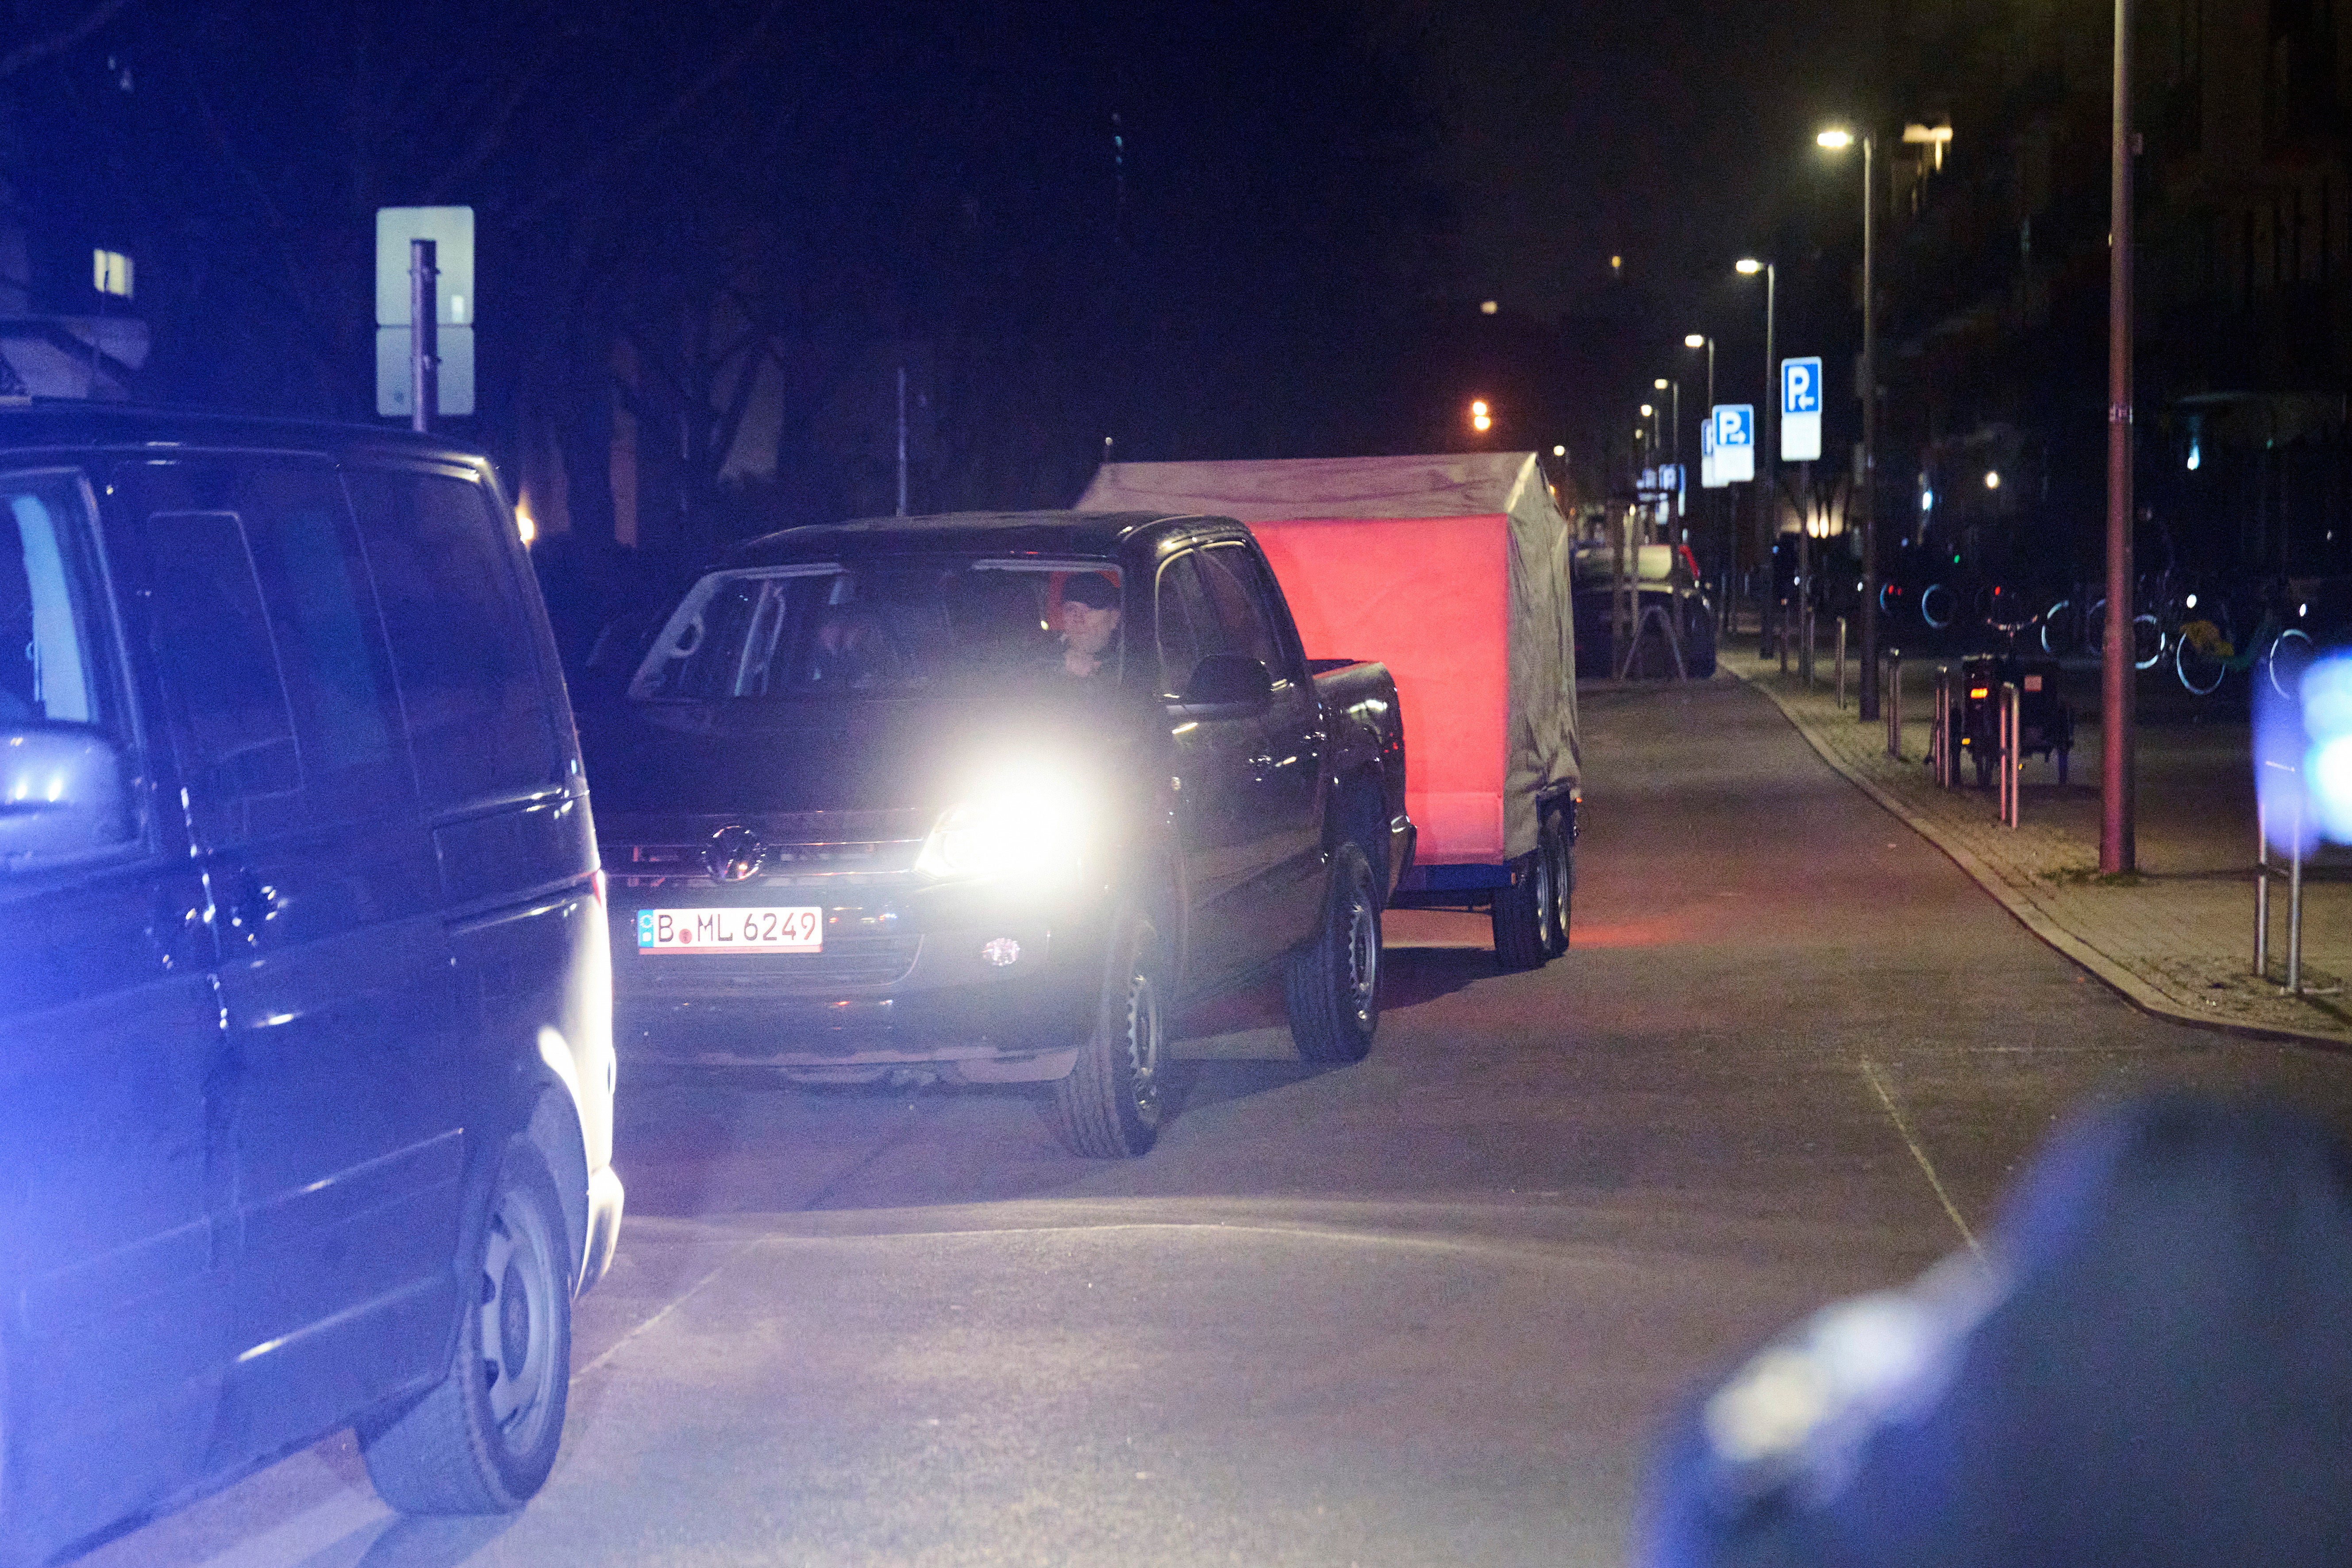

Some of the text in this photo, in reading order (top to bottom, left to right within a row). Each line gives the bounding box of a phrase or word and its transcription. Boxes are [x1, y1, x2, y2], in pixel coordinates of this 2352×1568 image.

[1788, 366, 1810, 412] P
[1719, 411, 1741, 444] P
[658, 912, 816, 942] B ML 6249
